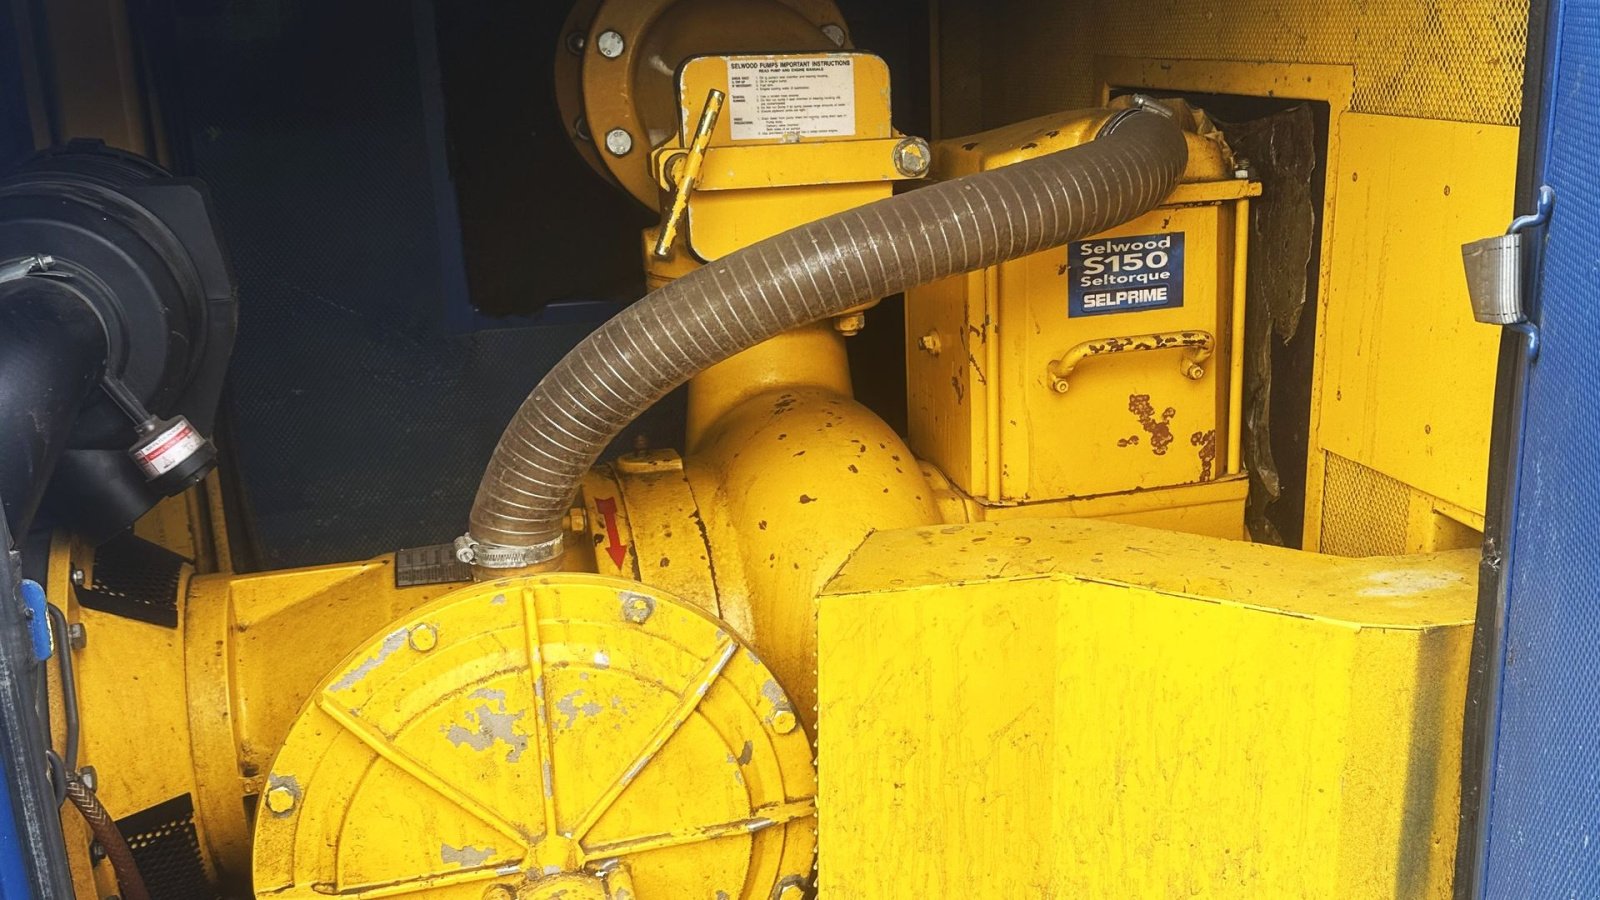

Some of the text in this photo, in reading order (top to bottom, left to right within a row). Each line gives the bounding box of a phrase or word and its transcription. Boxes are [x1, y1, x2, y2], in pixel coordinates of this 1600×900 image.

[1081, 236, 1171, 256] Selwood
[1083, 250, 1169, 275] S150
[1080, 271, 1171, 287] Seltorque
[1083, 287, 1167, 308] SELPRIME
